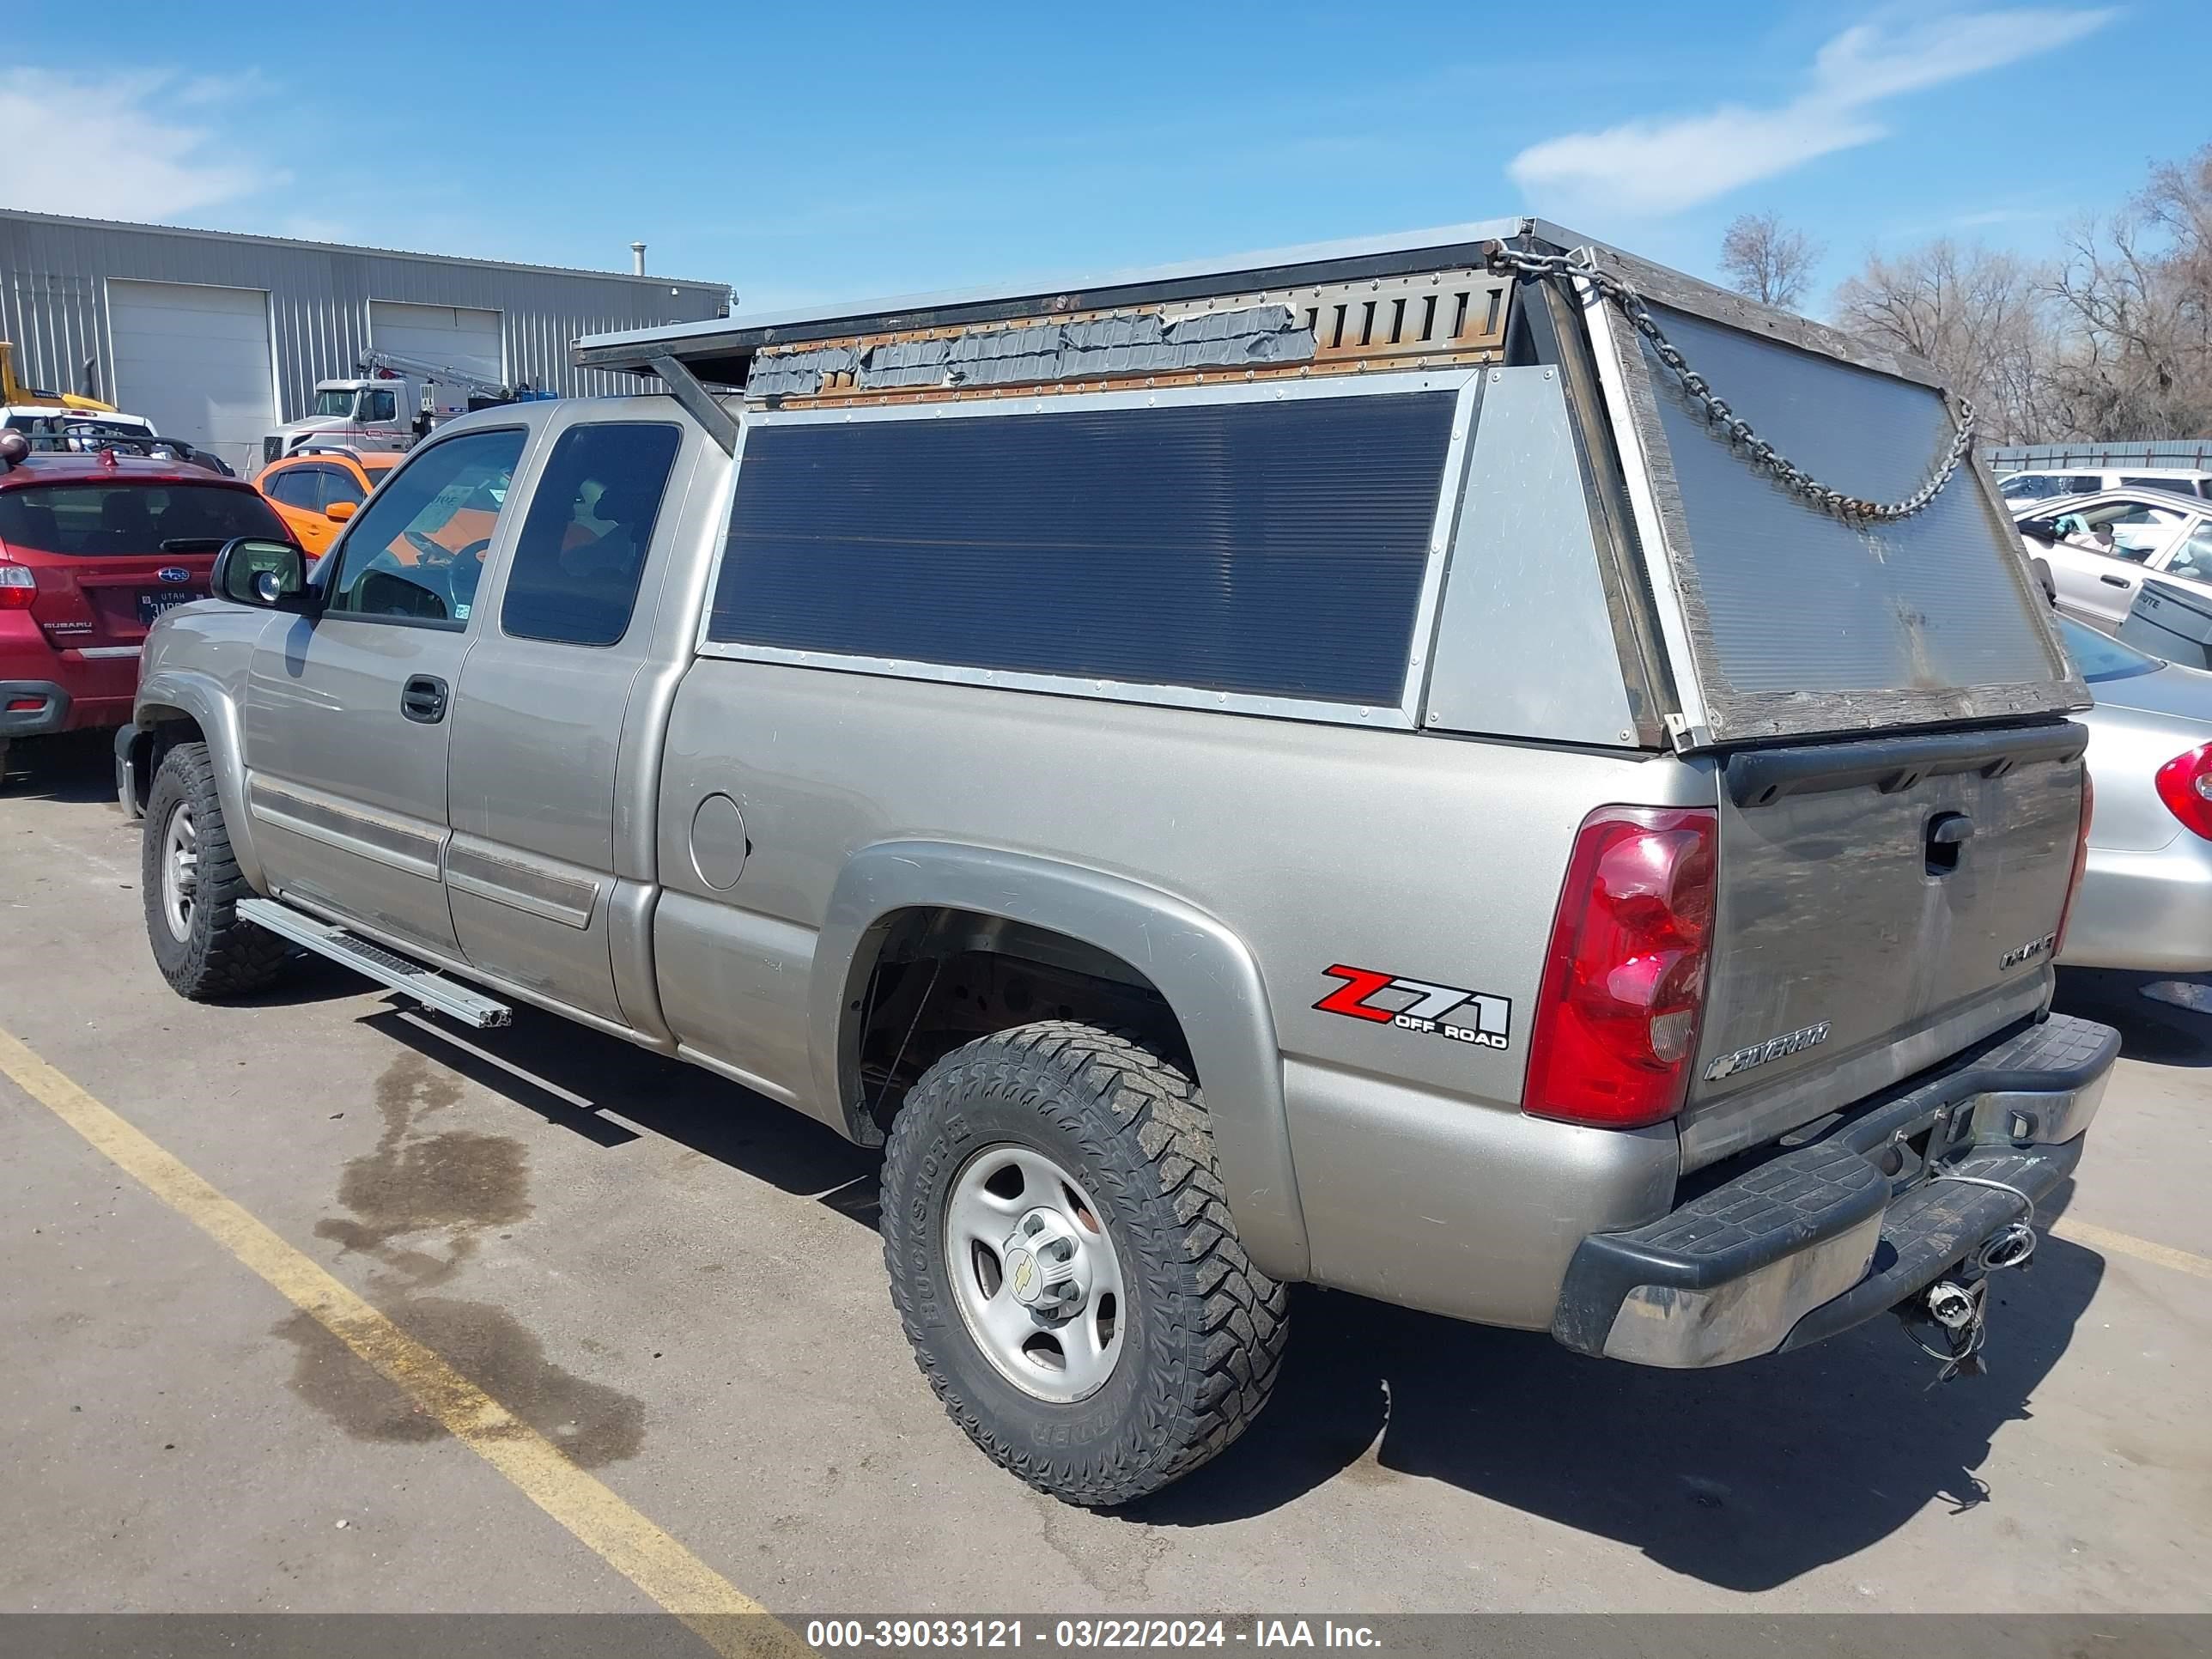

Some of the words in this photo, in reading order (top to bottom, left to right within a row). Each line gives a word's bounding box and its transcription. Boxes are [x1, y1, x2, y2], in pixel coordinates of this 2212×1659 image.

[161, 592, 185, 601] UTAH
[1311, 963, 1512, 1036] Z71
[1394, 1014, 1436, 1033] OFF
[1444, 1024, 1509, 1049] ROAD
[1731, 1020, 1833, 1074] SILVERADO
[910, 1135, 949, 1322] BUCKSHOT
